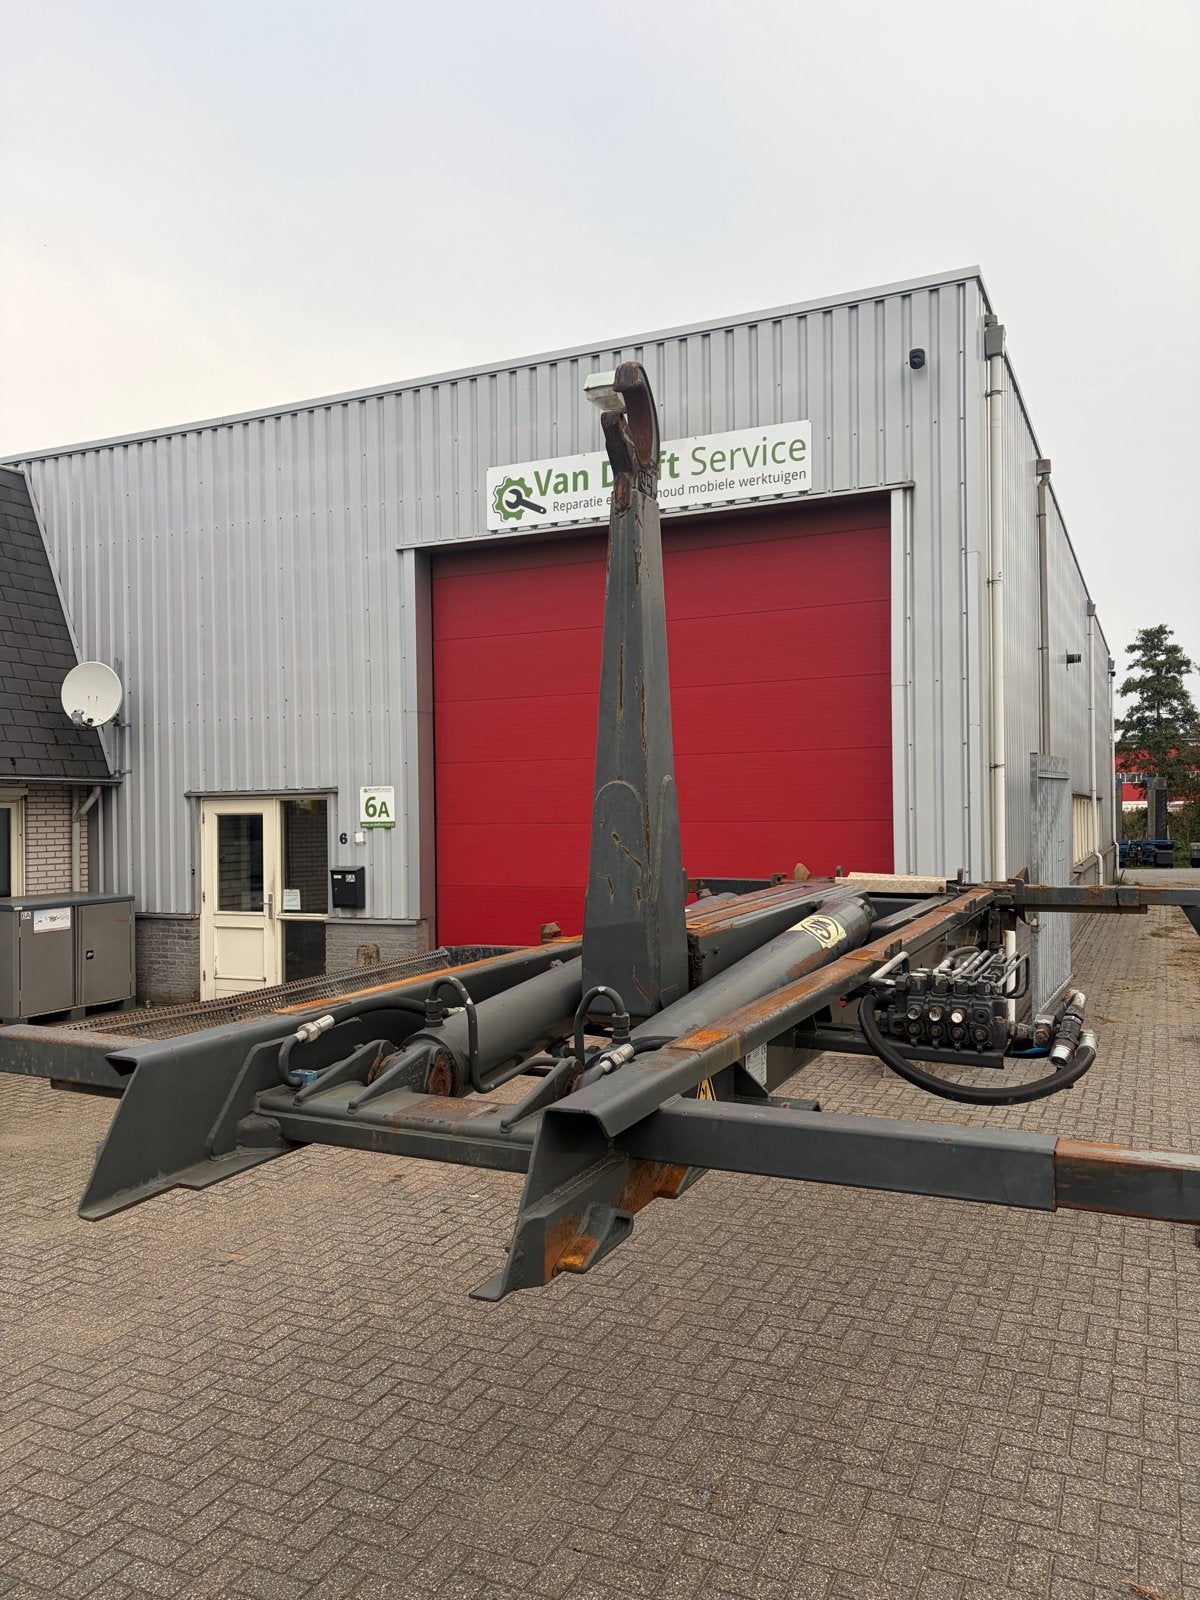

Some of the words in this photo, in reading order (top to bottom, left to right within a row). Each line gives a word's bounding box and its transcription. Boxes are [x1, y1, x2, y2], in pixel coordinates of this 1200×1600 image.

[533, 468, 589, 497] Van
[690, 436, 807, 476] Service
[553, 496, 603, 514] Reparatie
[688, 477, 736, 495] mobiele
[738, 470, 807, 488] werktuigen
[365, 796, 390, 818] 6A
[339, 832, 348, 845] 6
